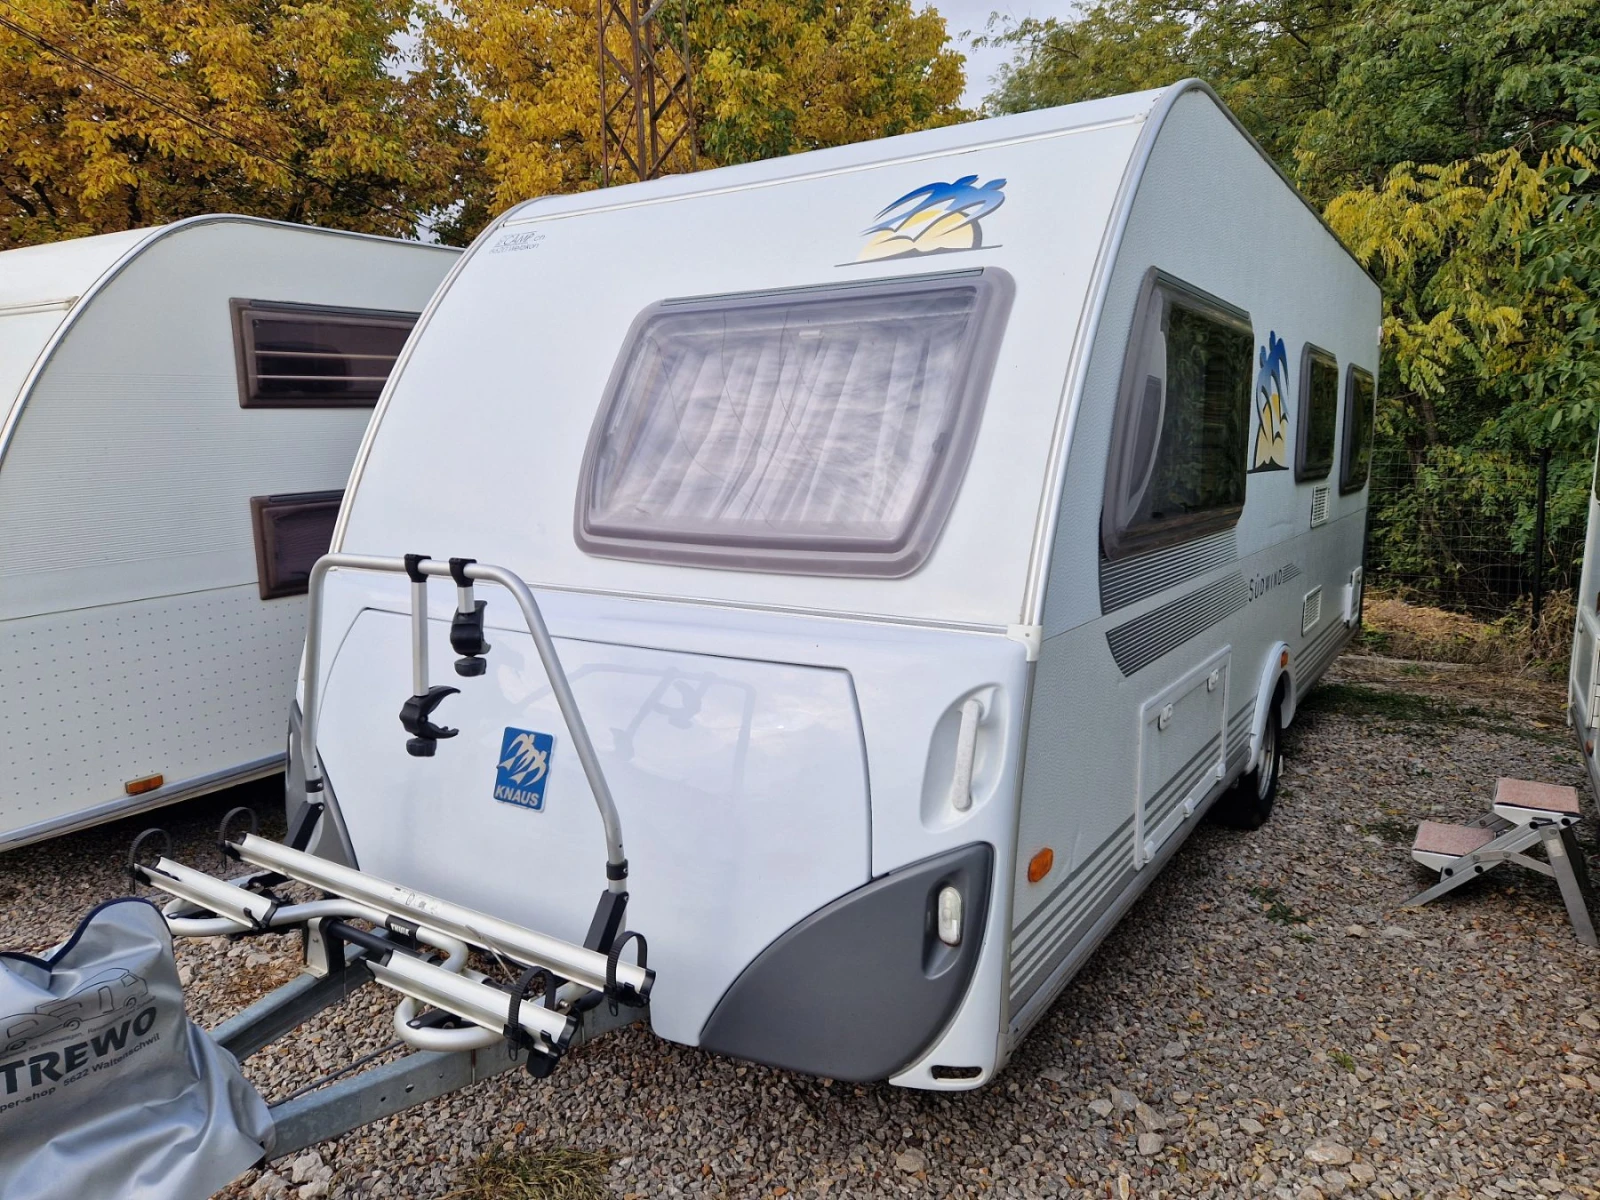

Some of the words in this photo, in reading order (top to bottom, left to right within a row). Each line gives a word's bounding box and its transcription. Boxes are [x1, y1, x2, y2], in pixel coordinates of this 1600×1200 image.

[495, 785, 539, 806] KNAUS
[0, 1006, 157, 1095] TREWO
[64, 1068, 89, 1087] 5622
[92, 1032, 160, 1072] Waltenschwil
